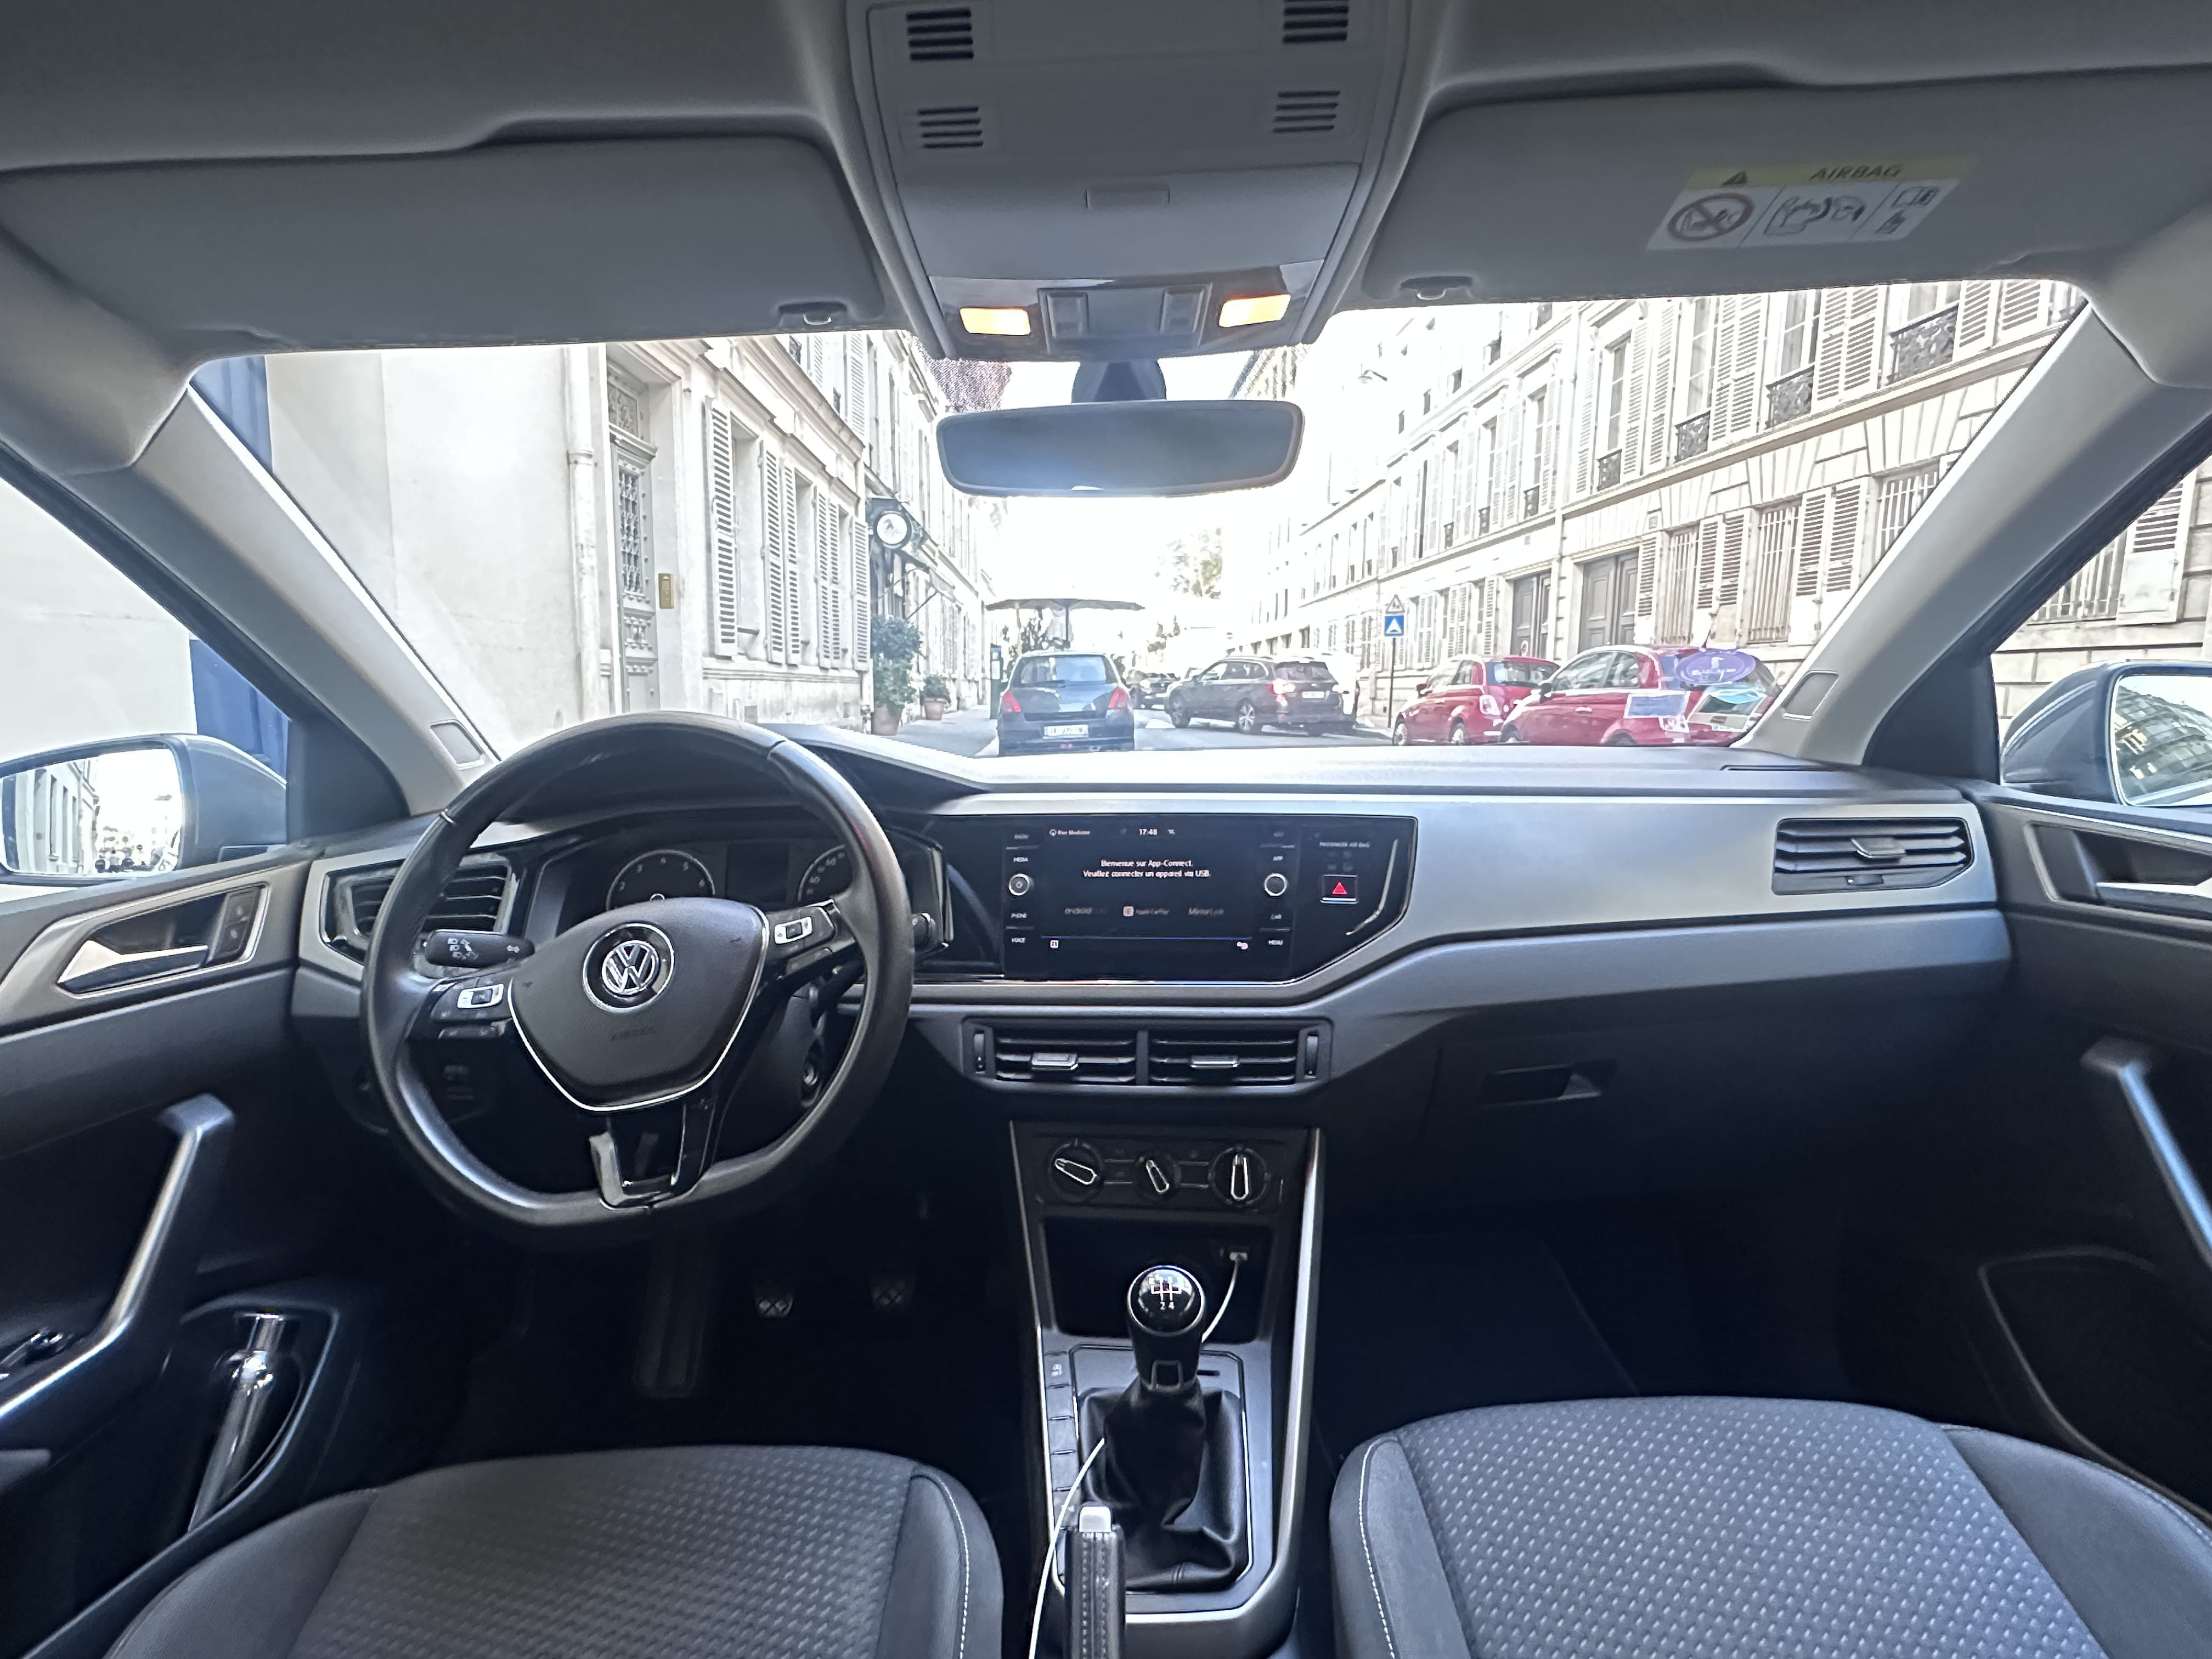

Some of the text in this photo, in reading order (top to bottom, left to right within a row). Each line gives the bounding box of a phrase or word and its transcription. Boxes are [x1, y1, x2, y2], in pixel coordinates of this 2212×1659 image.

[1808, 165, 1904, 182] AIRBAG
[1160, 1301, 1174, 1310] 2 4
